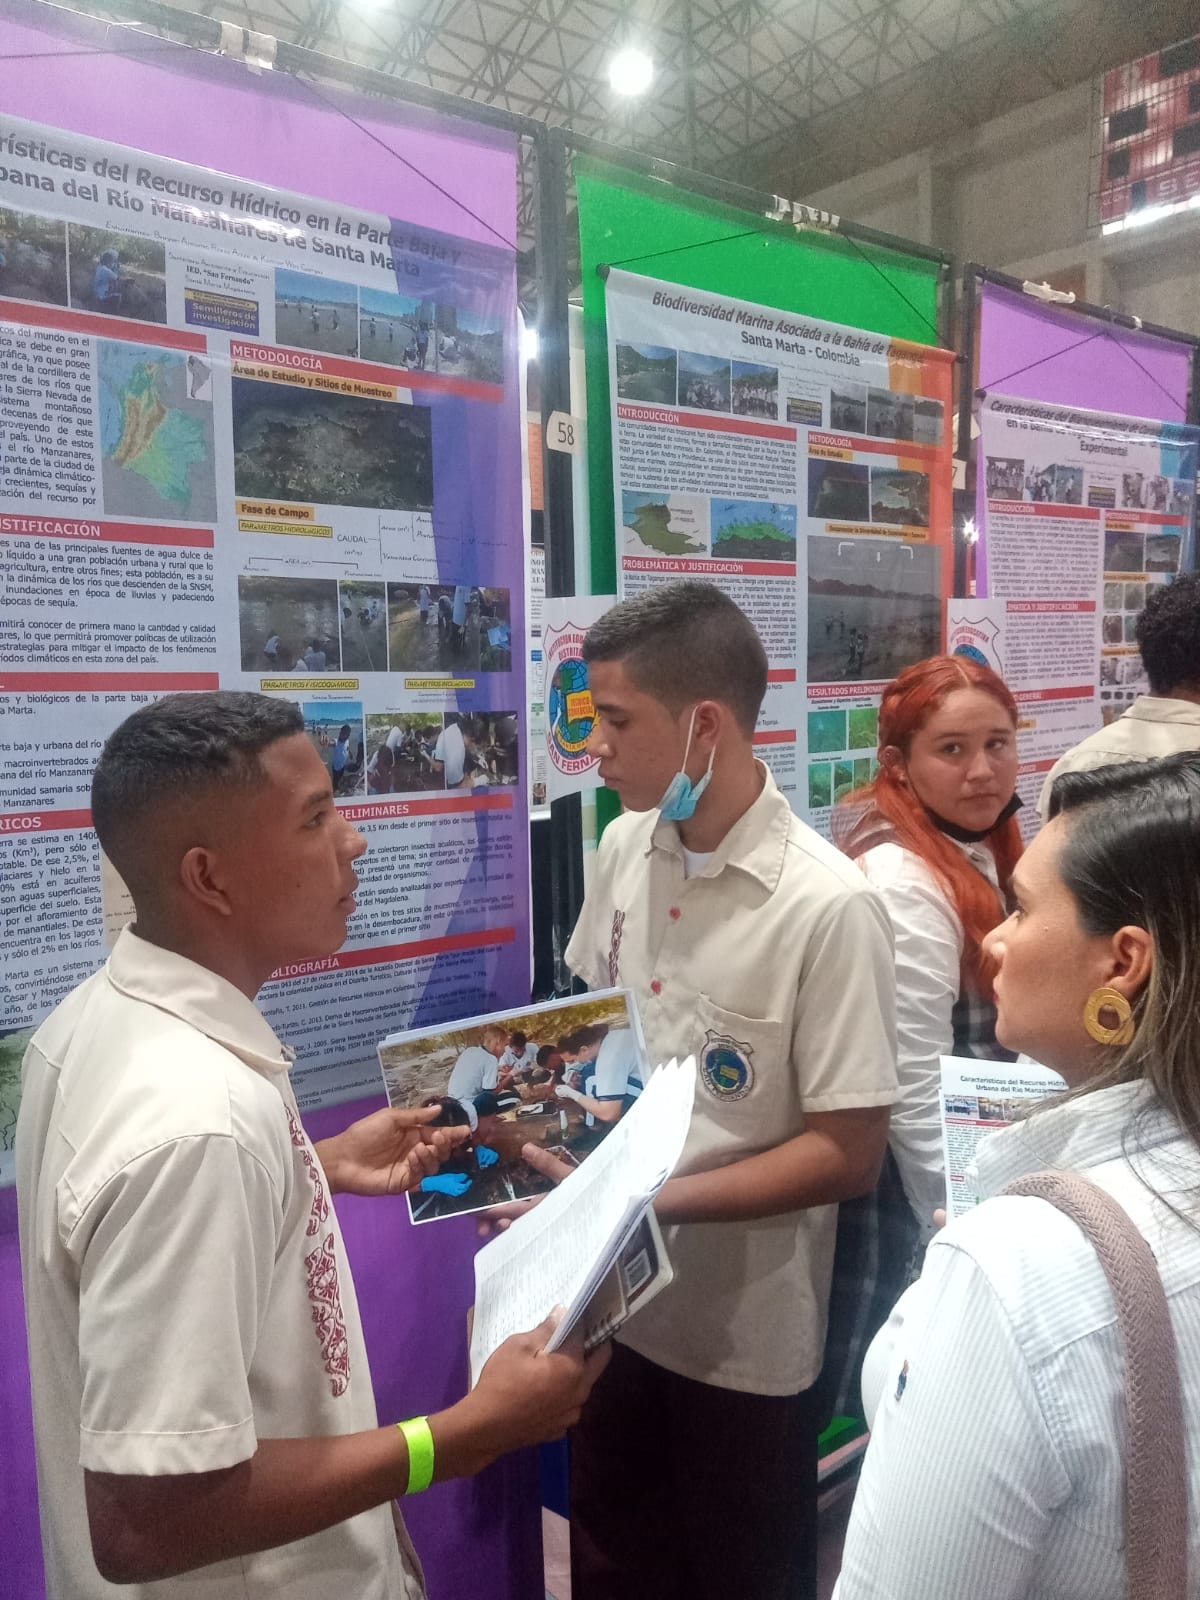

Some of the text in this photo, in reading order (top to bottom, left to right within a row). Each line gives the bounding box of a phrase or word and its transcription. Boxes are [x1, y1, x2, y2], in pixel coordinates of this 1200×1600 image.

[93, 158, 129, 183] del
[136, 167, 224, 206] Recurso
[229, 190, 300, 225] Hídrico
[306, 212, 329, 231] en
[335, 216, 351, 237] la
[357, 222, 405, 249] Parte
[62, 178, 98, 203] del
[106, 186, 144, 213] Río
[312, 236, 365, 264] Santa
[370, 250, 420, 277] Marta
[652, 291, 735, 323] Biodiversidad
[735, 310, 774, 331] Marina
[775, 319, 823, 341] Asociada
[823, 333, 829, 342] a
[831, 332, 841, 346] la
[843, 334, 869, 352] Bahía
[871, 341, 885, 355] de
[232, 345, 323, 370] METODOLOGÍA
[741, 331, 773, 348] Santa
[776, 338, 806, 355] Marta
[815, 346, 860, 367] Colombia
[12, 362, 90, 380] de la cordillera de
[258, 368, 269, 378] de
[272, 370, 305, 384] Estudio
[308, 378, 313, 387] y
[315, 377, 339, 390] Sitios
[341, 381, 352, 391] de
[354, 384, 392, 398] Muestreo
[5, 384, 91, 403] la Sierra Nevada de
[2, 408, 37, 419] decenas
[42, 413, 53, 421] de
[77, 418, 93, 426] que
[618, 407, 679, 423] INTRODUCCIÓN
[558, 422, 575, 445] 58
[8, 443, 93, 461] el río Manzanares,
[5, 455, 95, 471] parte de la ciudad de
[14, 466, 95, 482] dinámica climático-
[5, 478, 51, 491] crecientes,
[90, 487, 95, 495] y
[241, 504, 309, 519] Fase de Campo
[337, 534, 368, 543] CAUDAL
[14, 541, 30, 549] una
[34, 541, 45, 549] de
[49, 542, 61, 550] las
[65, 544, 108, 554] principales
[112, 546, 141, 555] fuentes
[145, 548, 154, 556] de
[158, 551, 176, 559] agua
[180, 550, 200, 559] dulce
[204, 552, 213, 560] de
[623, 559, 743, 572] PROBLEMÁTICA Y JUSTIFICACIÓN
[0, 596, 31, 606] épocas
[34, 597, 45, 605] de
[28, 621, 63, 629] conocer
[65, 621, 76, 629] de
[79, 622, 110, 631] primera
[138, 622, 145, 631] la
[148, 624, 180, 632] cantidad
[189, 624, 216, 632] calidad
[808, 687, 848, 697] RESULTADOS
[358, 825, 365, 833] de
[378, 823, 389, 831] Km
[390, 821, 408, 831] desde
[410, 820, 416, 829] el
[418, 819, 437, 829] primer
[452, 817, 460, 825] de
[45, 847, 64, 855] pero
[70, 843, 86, 852] sólo
[4, 953, 9, 961] y
[12, 950, 28, 959] sólo
[31, 947, 39, 955] el
[41, 945, 55, 954] 2%
[58, 944, 68, 952] en
[71, 941, 81, 949] los
